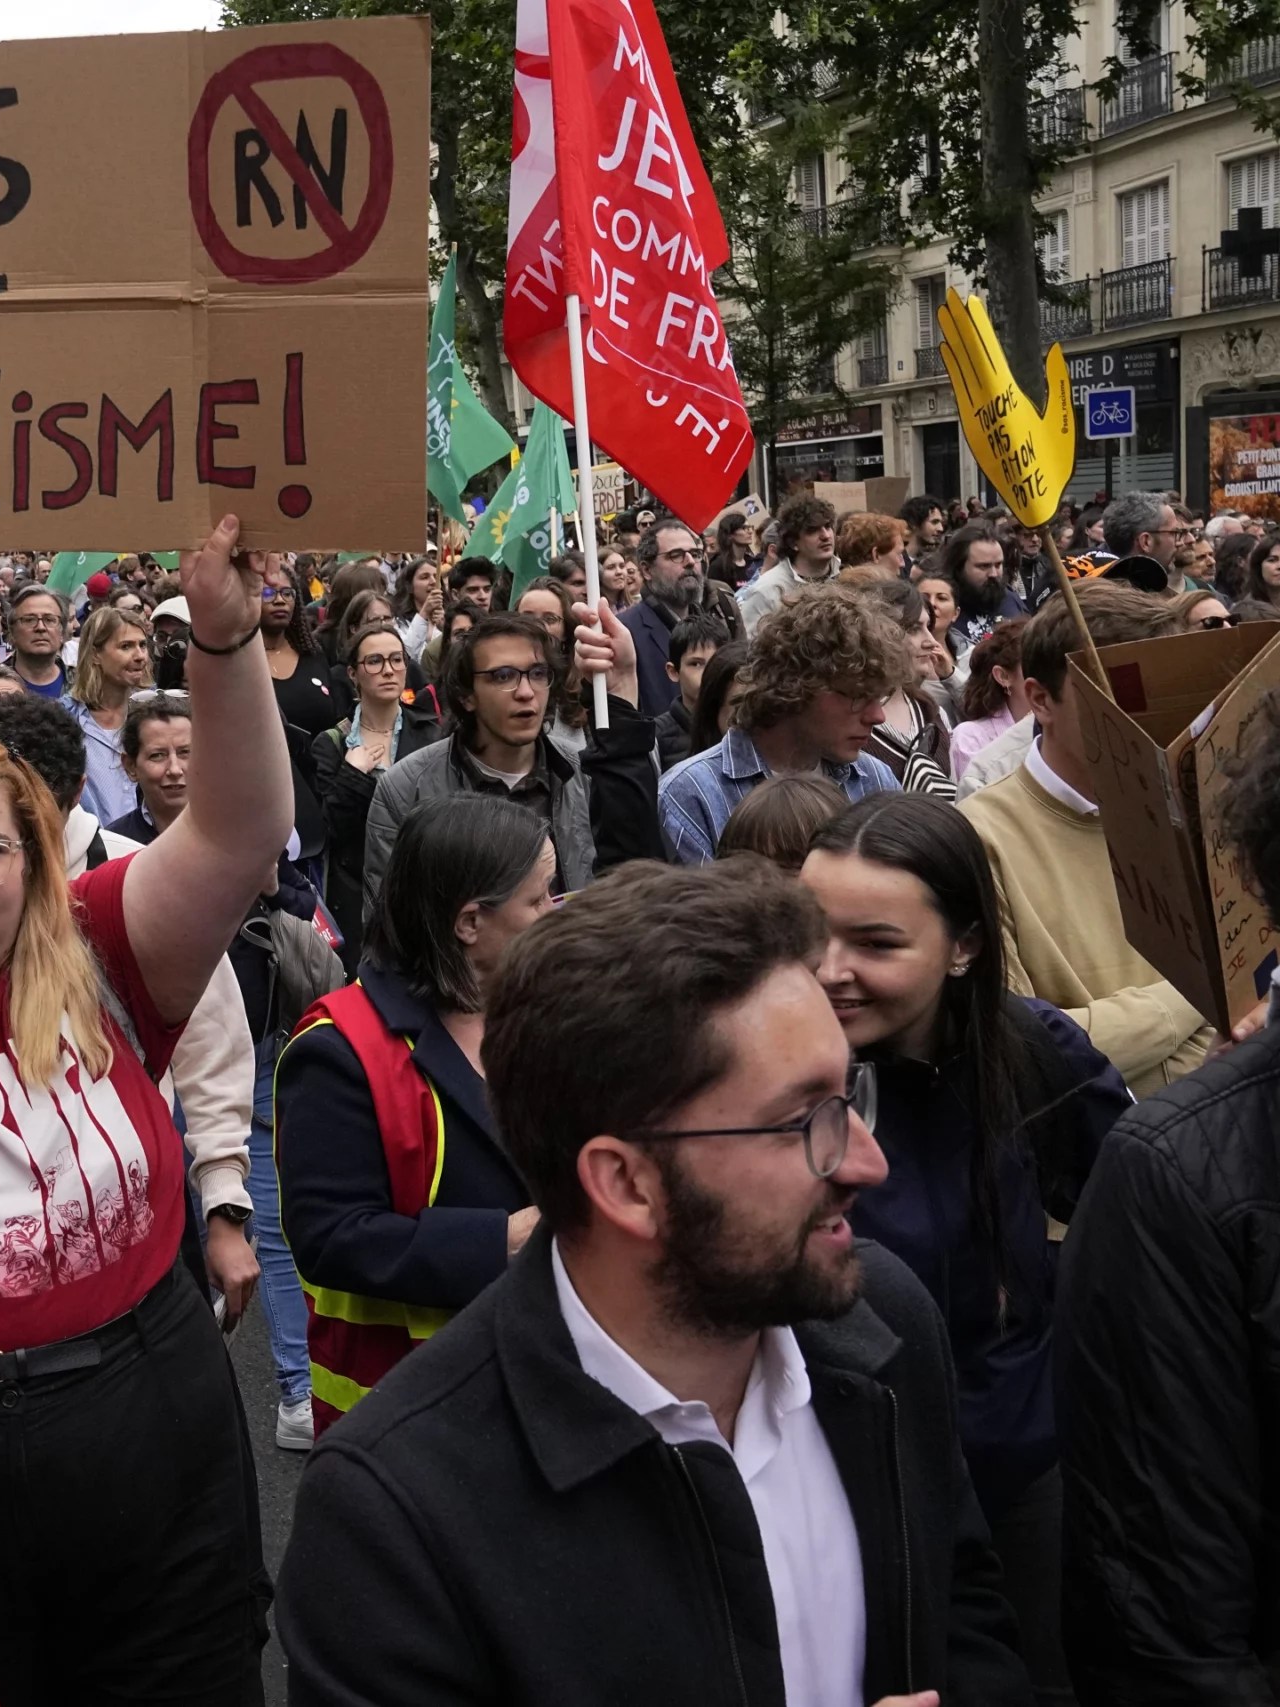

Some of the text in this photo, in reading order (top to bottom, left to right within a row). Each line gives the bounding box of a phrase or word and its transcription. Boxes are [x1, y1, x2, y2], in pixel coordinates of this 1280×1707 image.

[234, 107, 348, 231] RN
[593, 196, 716, 298] COMM
[591, 248, 636, 329] DE
[974, 383, 1018, 433] TOUCHE
[1061, 379, 1069, 435] @sos_racisme
[988, 425, 1011, 459] PAS
[1237, 450, 1260, 465] PETIT
[592, 488, 625, 515] ERDE
[1012, 468, 1048, 511] POTE
